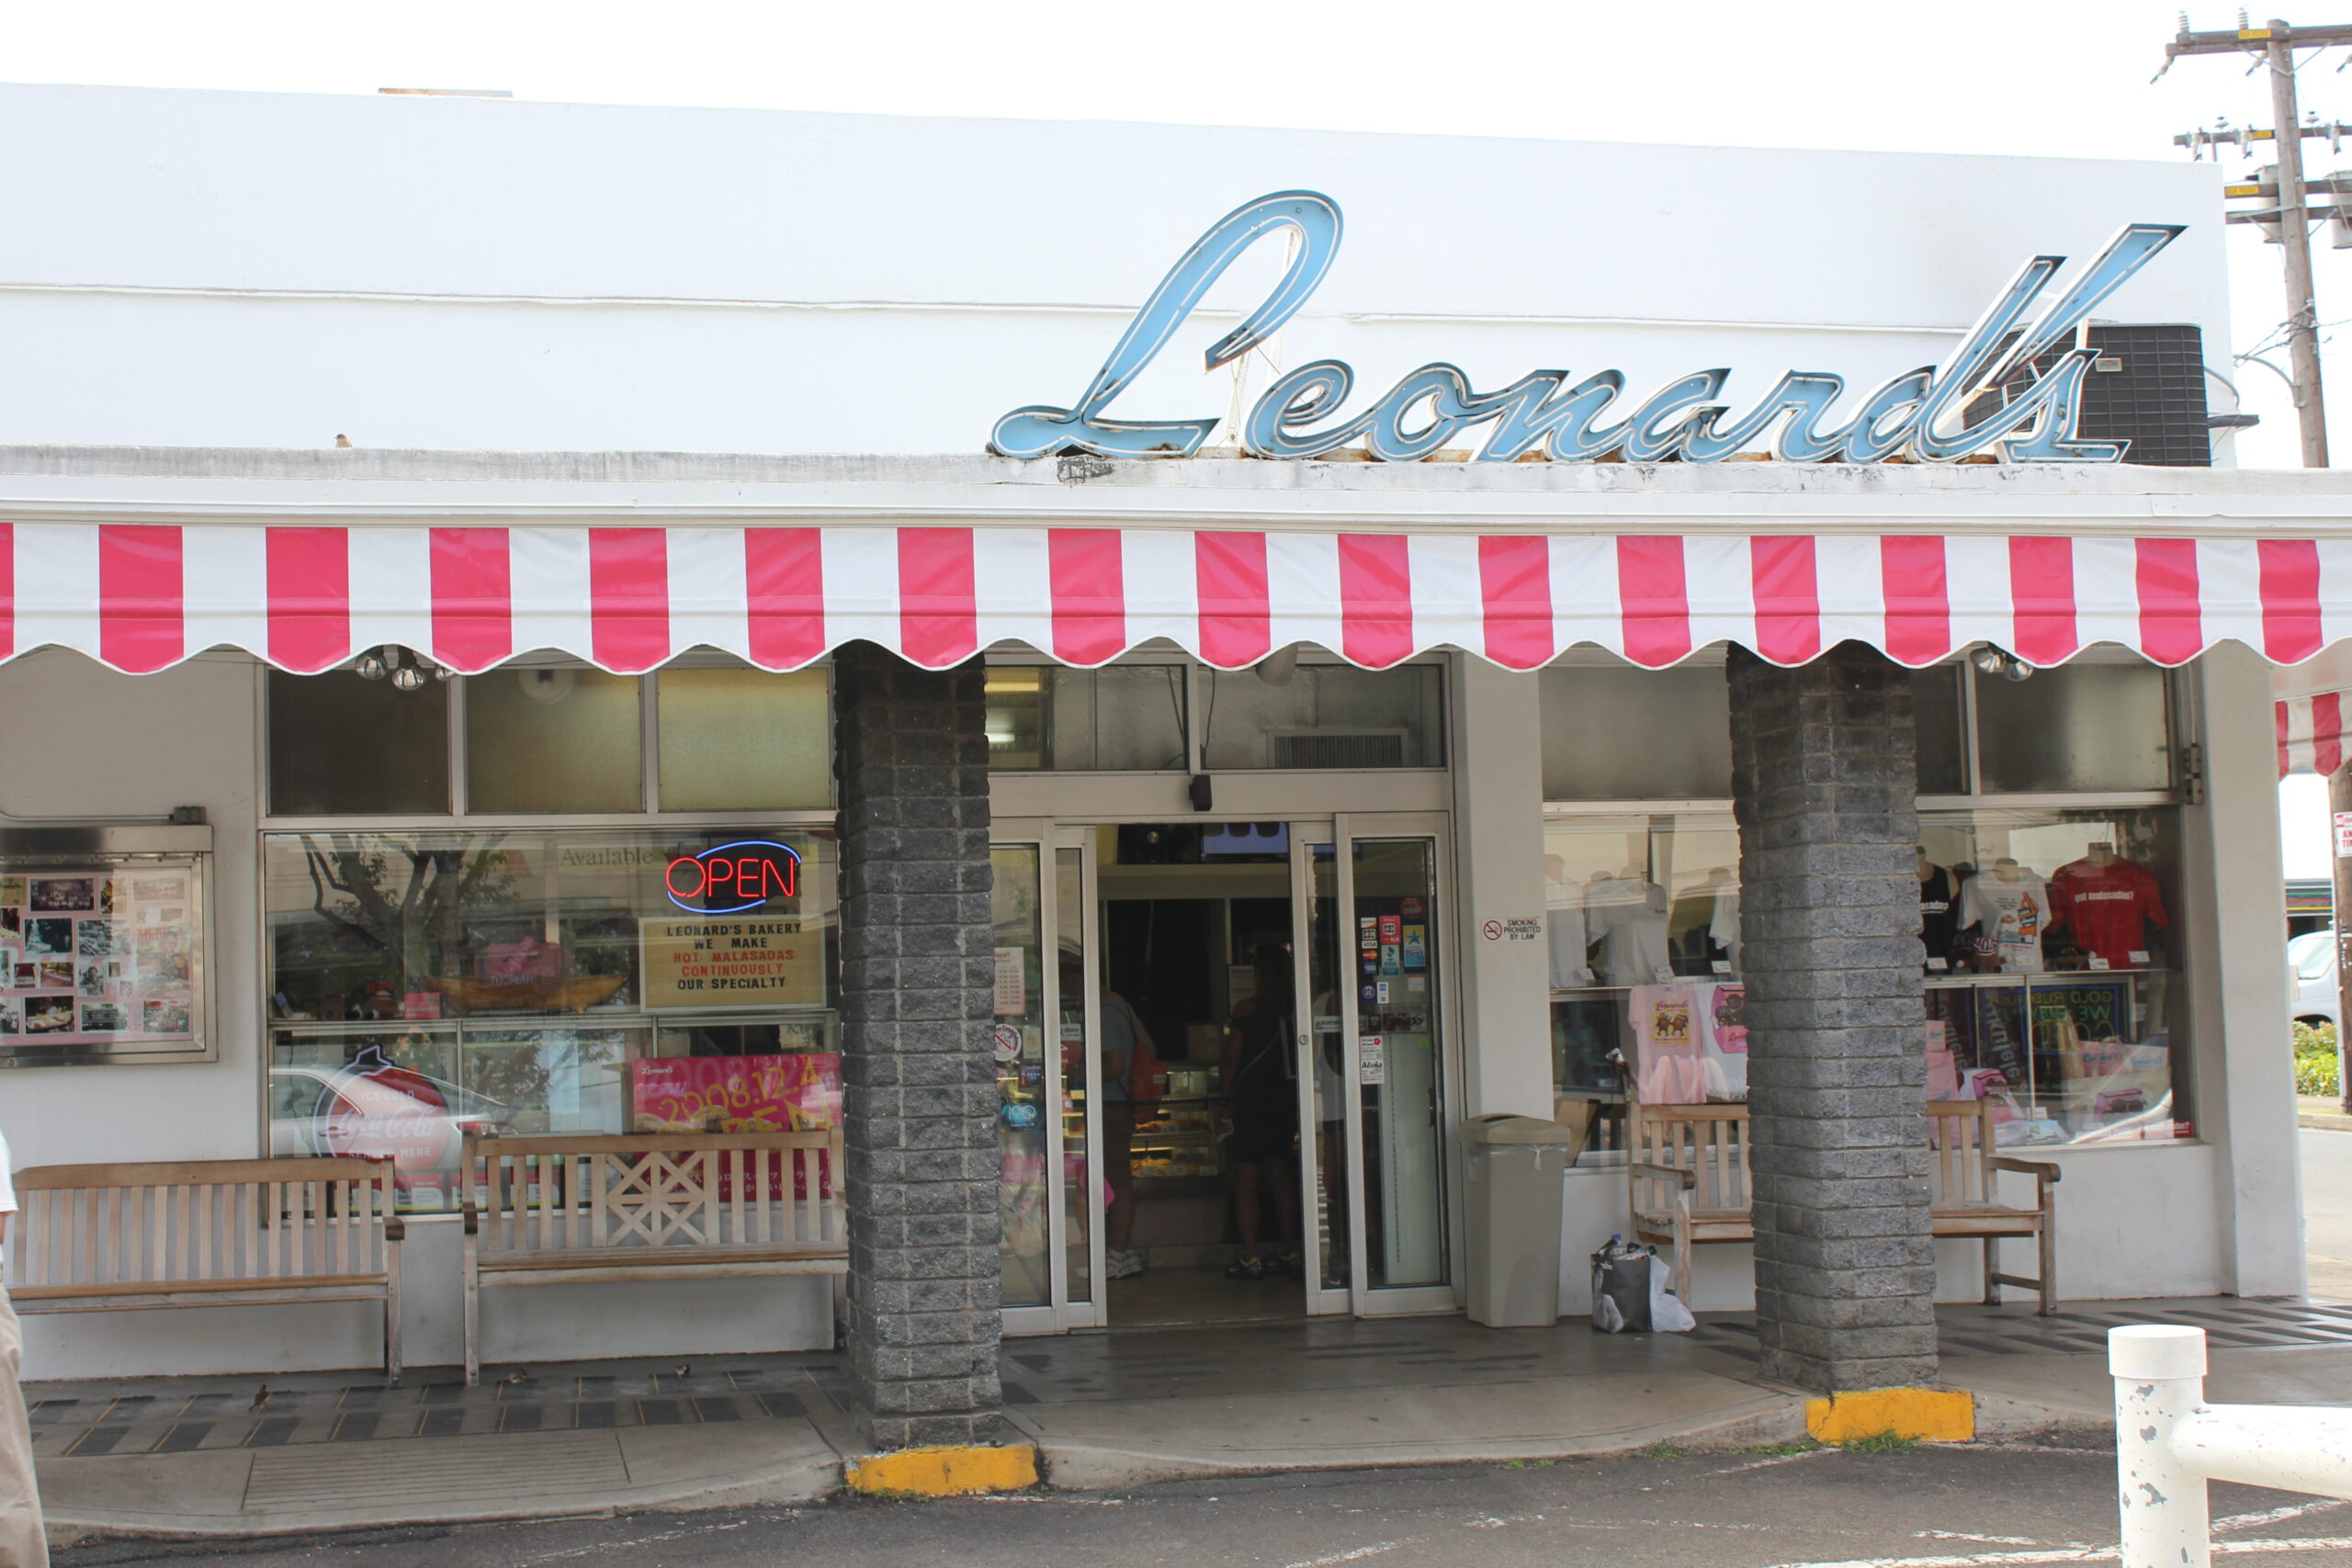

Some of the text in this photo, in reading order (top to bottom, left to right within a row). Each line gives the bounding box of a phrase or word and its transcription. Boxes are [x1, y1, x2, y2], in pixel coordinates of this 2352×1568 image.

[987, 189, 2188, 463] Leonard's
[560, 847, 653, 866] Available
[665, 857, 795, 897] OPEN
[2074, 892, 2086, 903] got
[667, 923, 801, 937] LEONARD'S BAKERY
[695, 938, 768, 950] WE MAKE
[673, 950, 795, 964] HOT MALASADAS
[682, 963, 784, 976] CONTINUOUSLY
[677, 977, 786, 990] OUR SPECIALTY
[363, 1090, 415, 1100] ICE COLD
[347, 1146, 433, 1159] SERVED HERE
